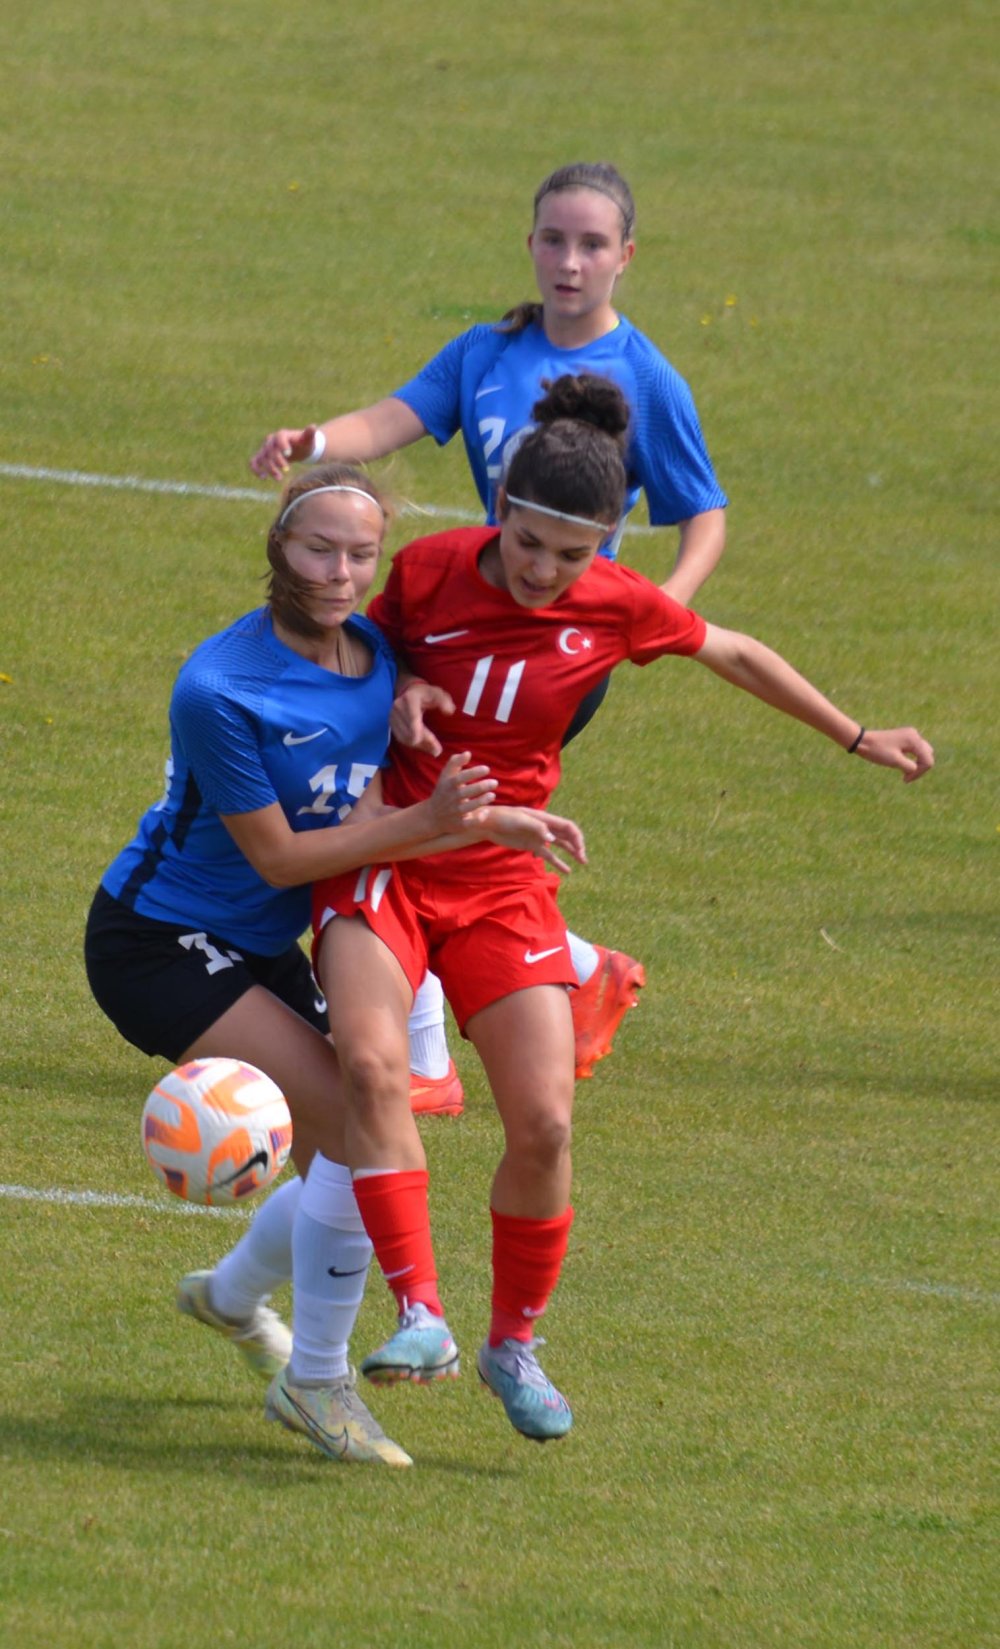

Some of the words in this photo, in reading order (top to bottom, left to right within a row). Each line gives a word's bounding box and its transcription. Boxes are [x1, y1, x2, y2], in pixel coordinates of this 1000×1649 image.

[478, 417, 536, 479] 2
[462, 654, 526, 723] 11
[177, 932, 244, 976] 1
